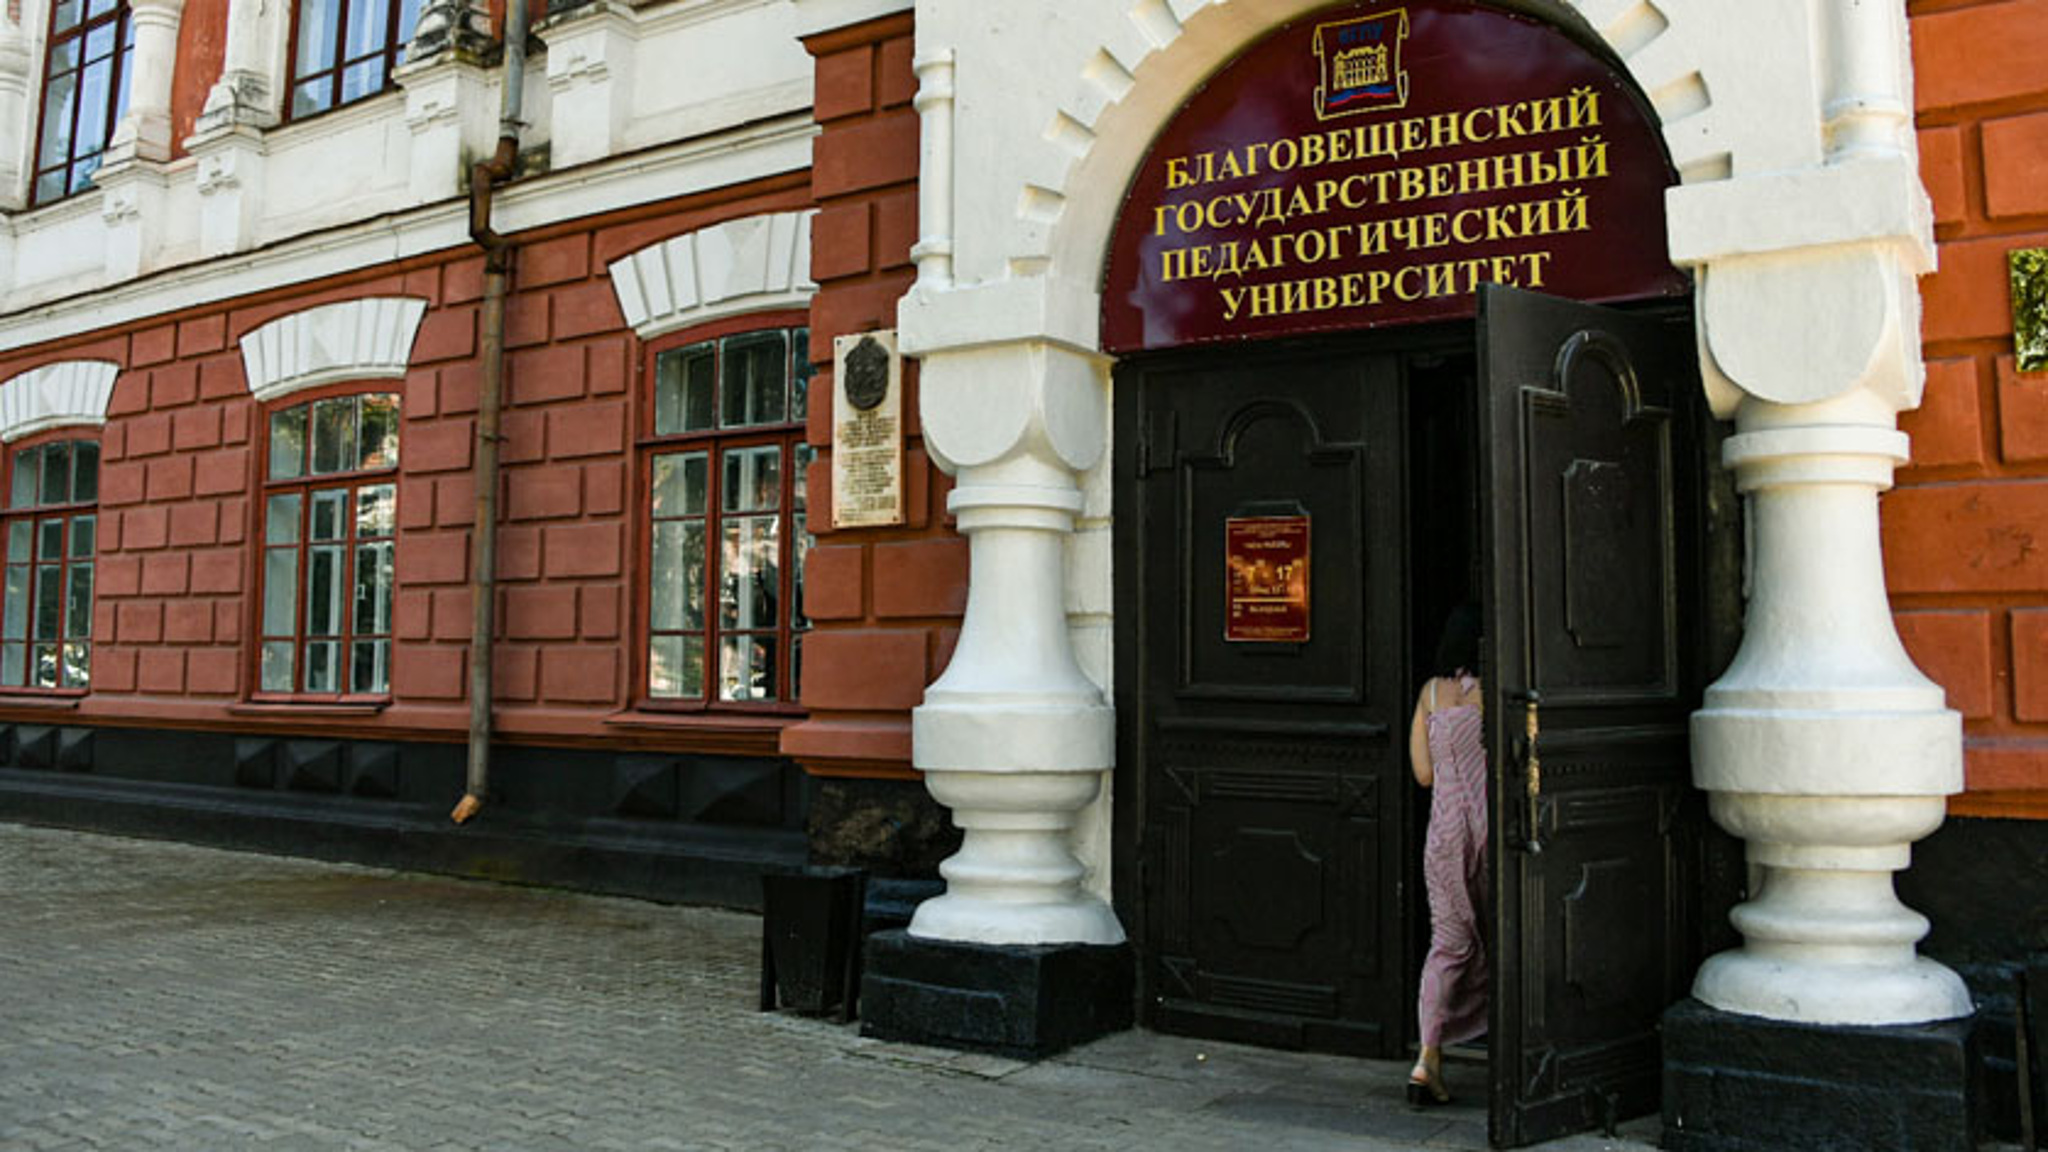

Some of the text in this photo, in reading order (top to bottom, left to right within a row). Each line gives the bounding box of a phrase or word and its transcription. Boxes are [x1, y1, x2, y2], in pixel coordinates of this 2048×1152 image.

[1154, 135, 1610, 237] ГОСУДАРСТВЕННЫЙ
[1165, 86, 1602, 190] БЛАГОВЕЩЕНСКИЙ
[1161, 187, 1591, 282] ПЕДАГОГИЧЕСКИЙ
[1219, 251, 1552, 323] УНИВЕРСИТЕТ
